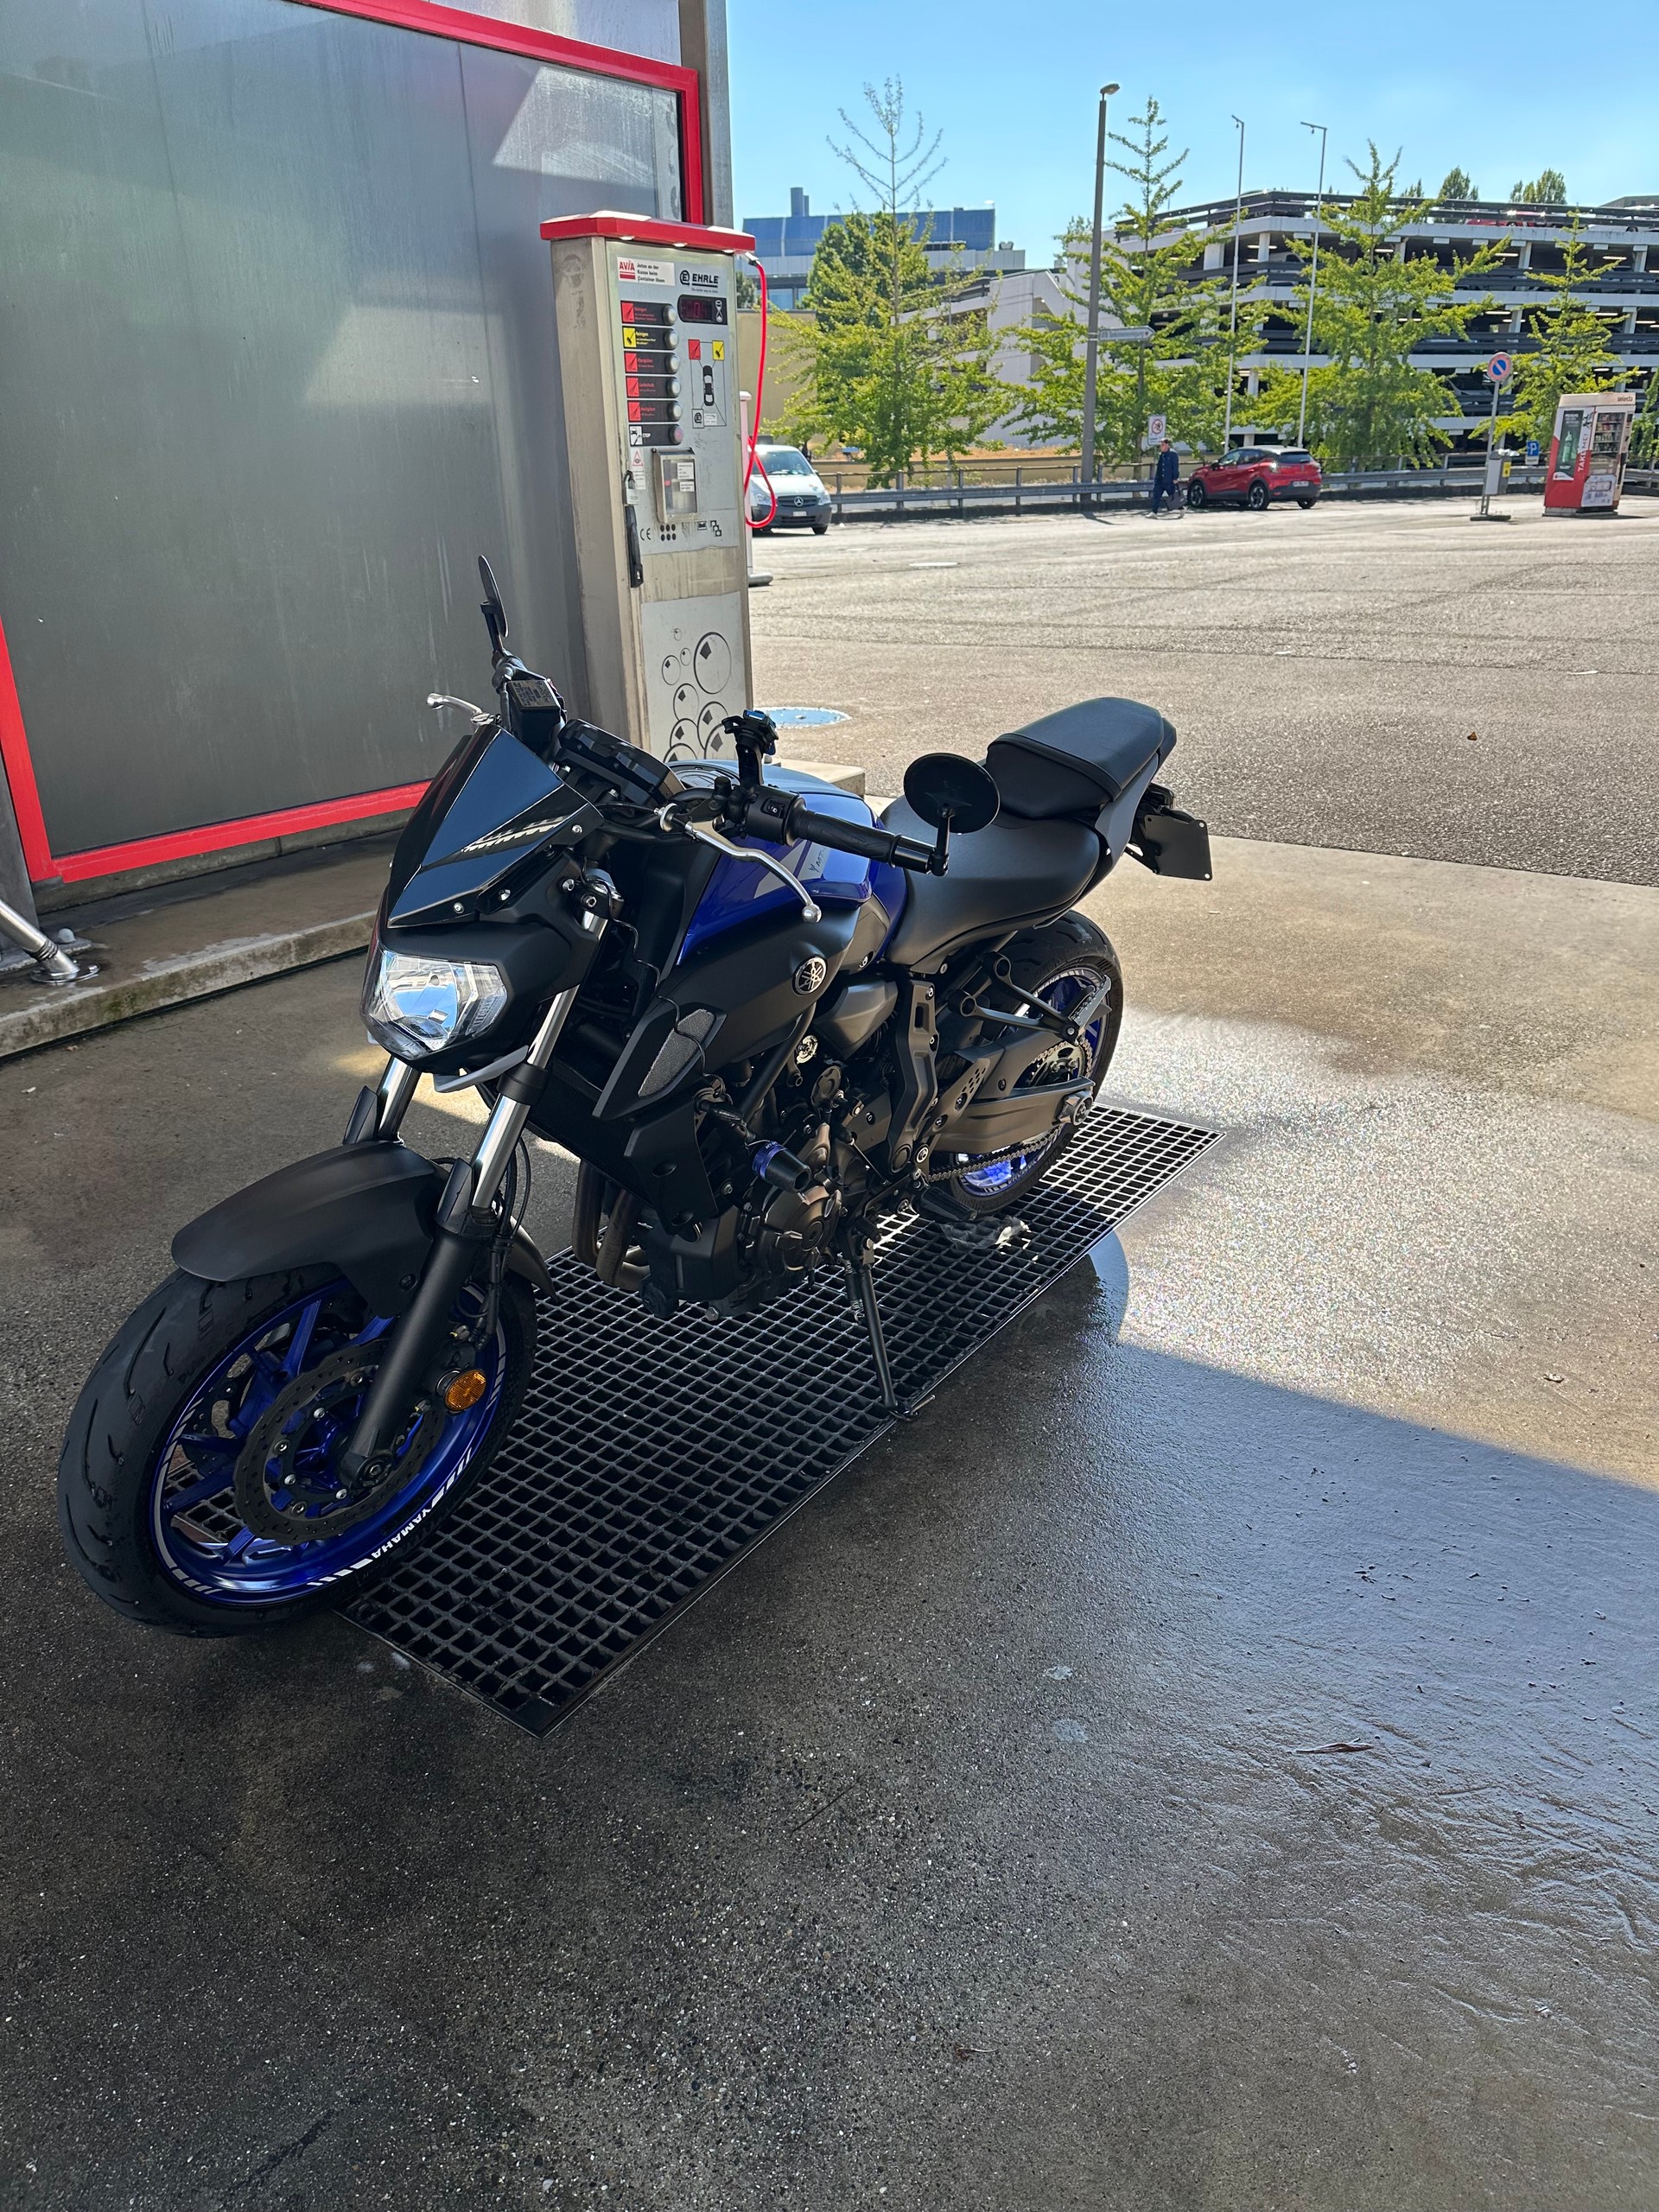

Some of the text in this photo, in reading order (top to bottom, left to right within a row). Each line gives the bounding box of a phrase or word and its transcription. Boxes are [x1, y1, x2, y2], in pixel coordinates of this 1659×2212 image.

[619, 260, 635, 271] AVIA
[692, 273, 719, 284] EHRLE
[1578, 450, 1586, 472] TAKE
[371, 1508, 432, 1559] YAMAHA
